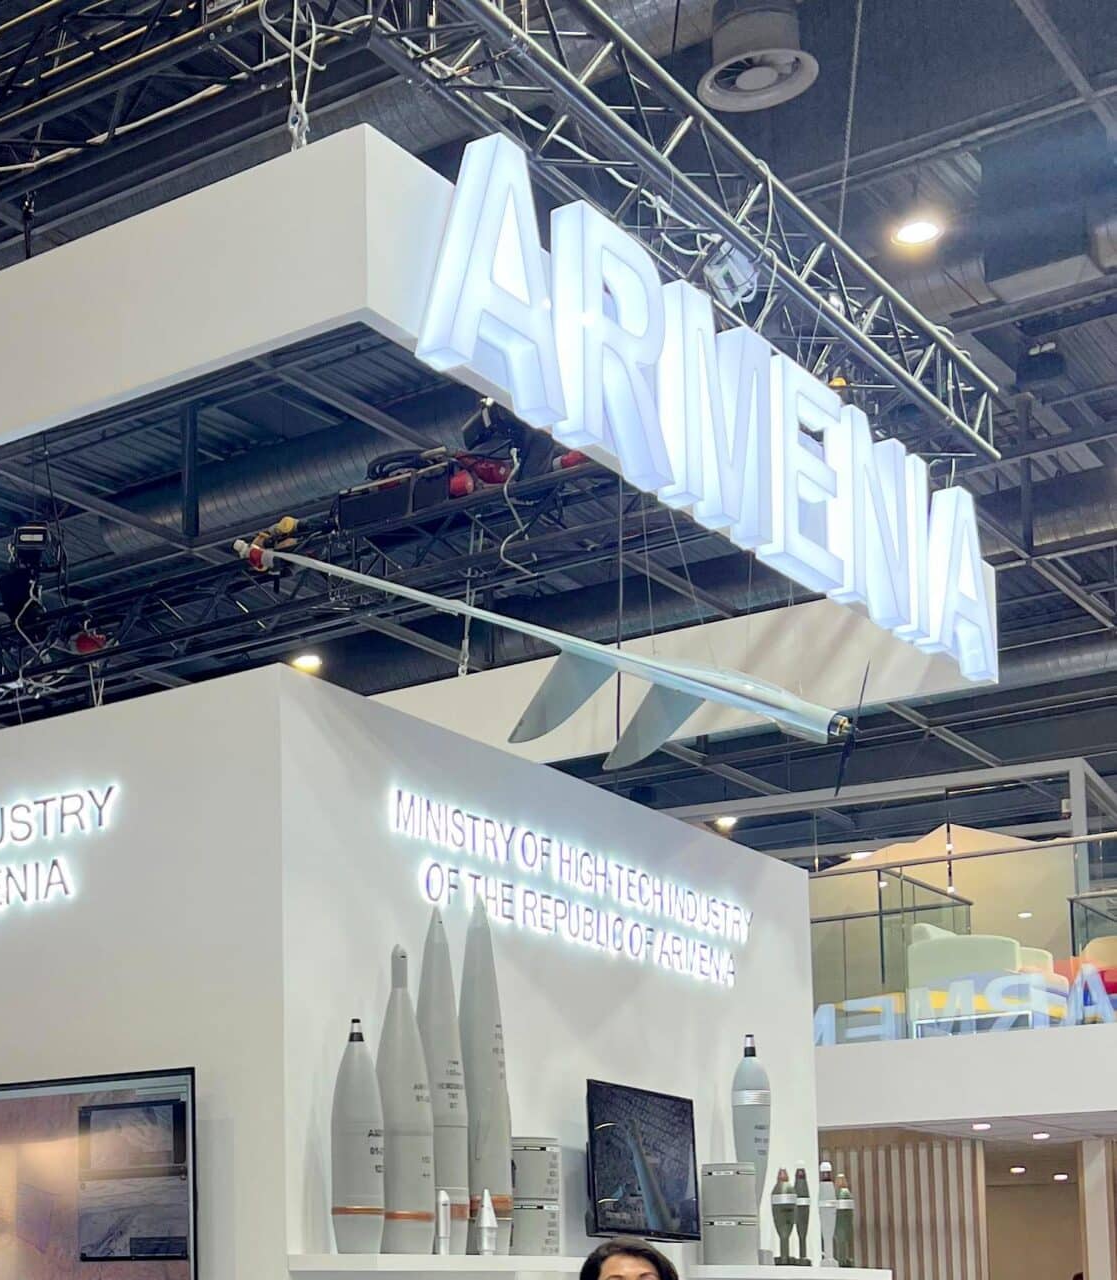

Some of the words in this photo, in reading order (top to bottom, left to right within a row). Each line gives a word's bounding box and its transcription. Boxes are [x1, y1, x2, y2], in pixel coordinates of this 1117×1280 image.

[415, 132, 998, 683] ARMENIA
[395, 788, 517, 863] MINISTRY
[521, 830, 552, 871] OF
[558, 843, 663, 909] HIGH-TECH
[669, 882, 754, 942] INDUSTRY
[425, 862, 460, 905] OF
[468, 872, 516, 922] THE
[522, 889, 625, 952] REPUBLIC
[629, 922, 655, 959] OF
